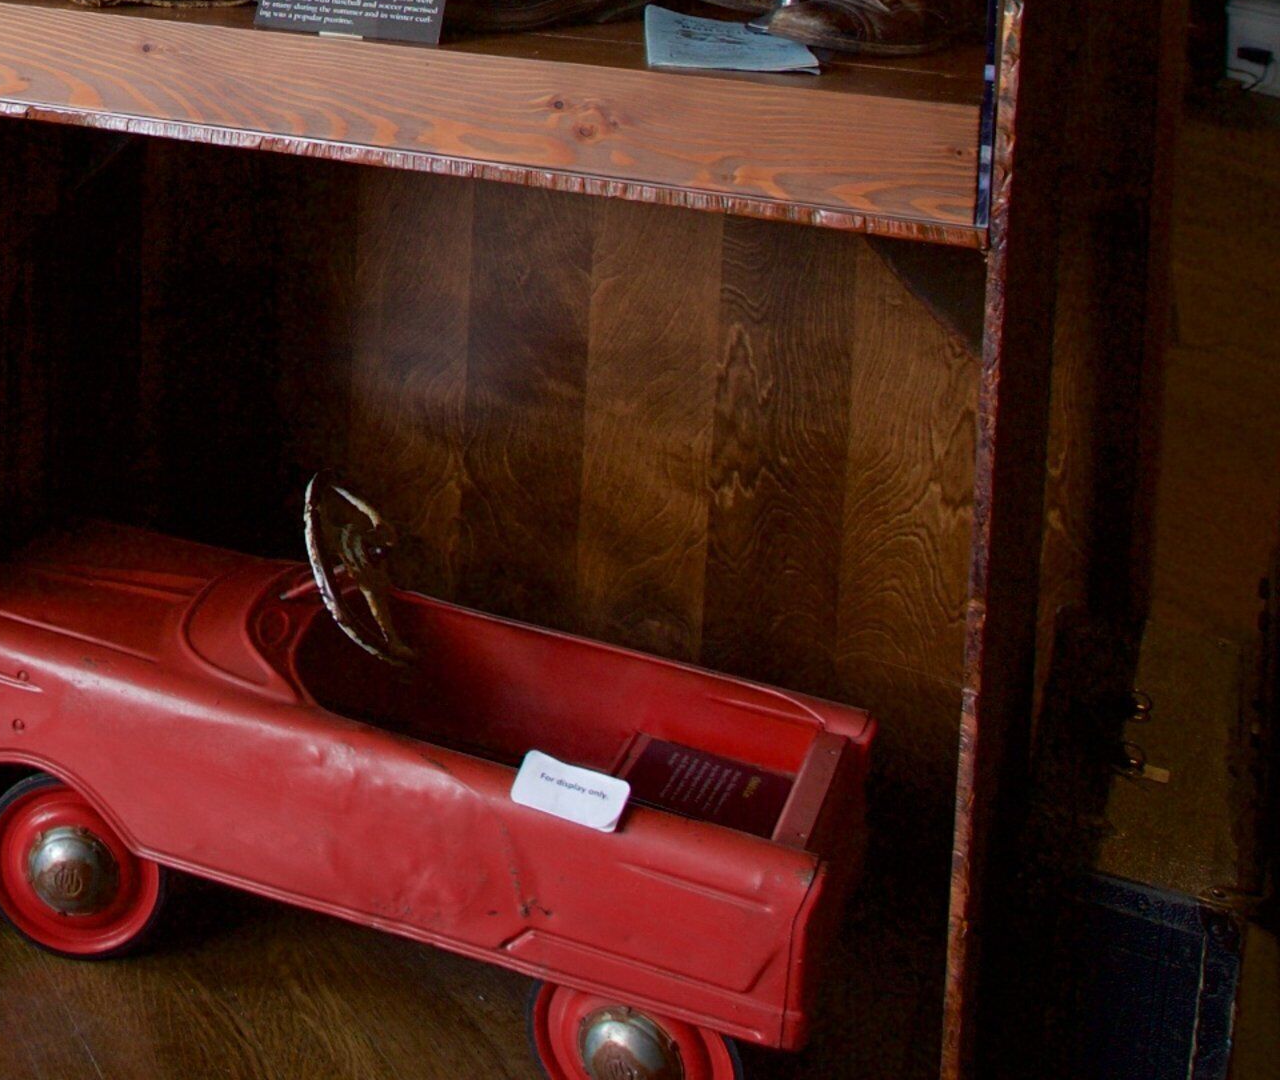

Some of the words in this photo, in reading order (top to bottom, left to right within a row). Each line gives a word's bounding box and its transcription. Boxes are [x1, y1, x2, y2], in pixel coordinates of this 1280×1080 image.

[262, 0, 271, 8] by
[272, 2, 292, 10] many
[293, 4, 318, 13] during
[319, 5, 331, 13] the
[332, 8, 363, 16] summer
[389, 13, 414, 21] winter
[378, 2, 402, 10] soccer
[260, 9, 271, 18] ing
[293, 14, 322, 22] popular
[540, 772, 554, 783] For
[556, 778, 587, 794] display
[588, 787, 609, 800] only.
